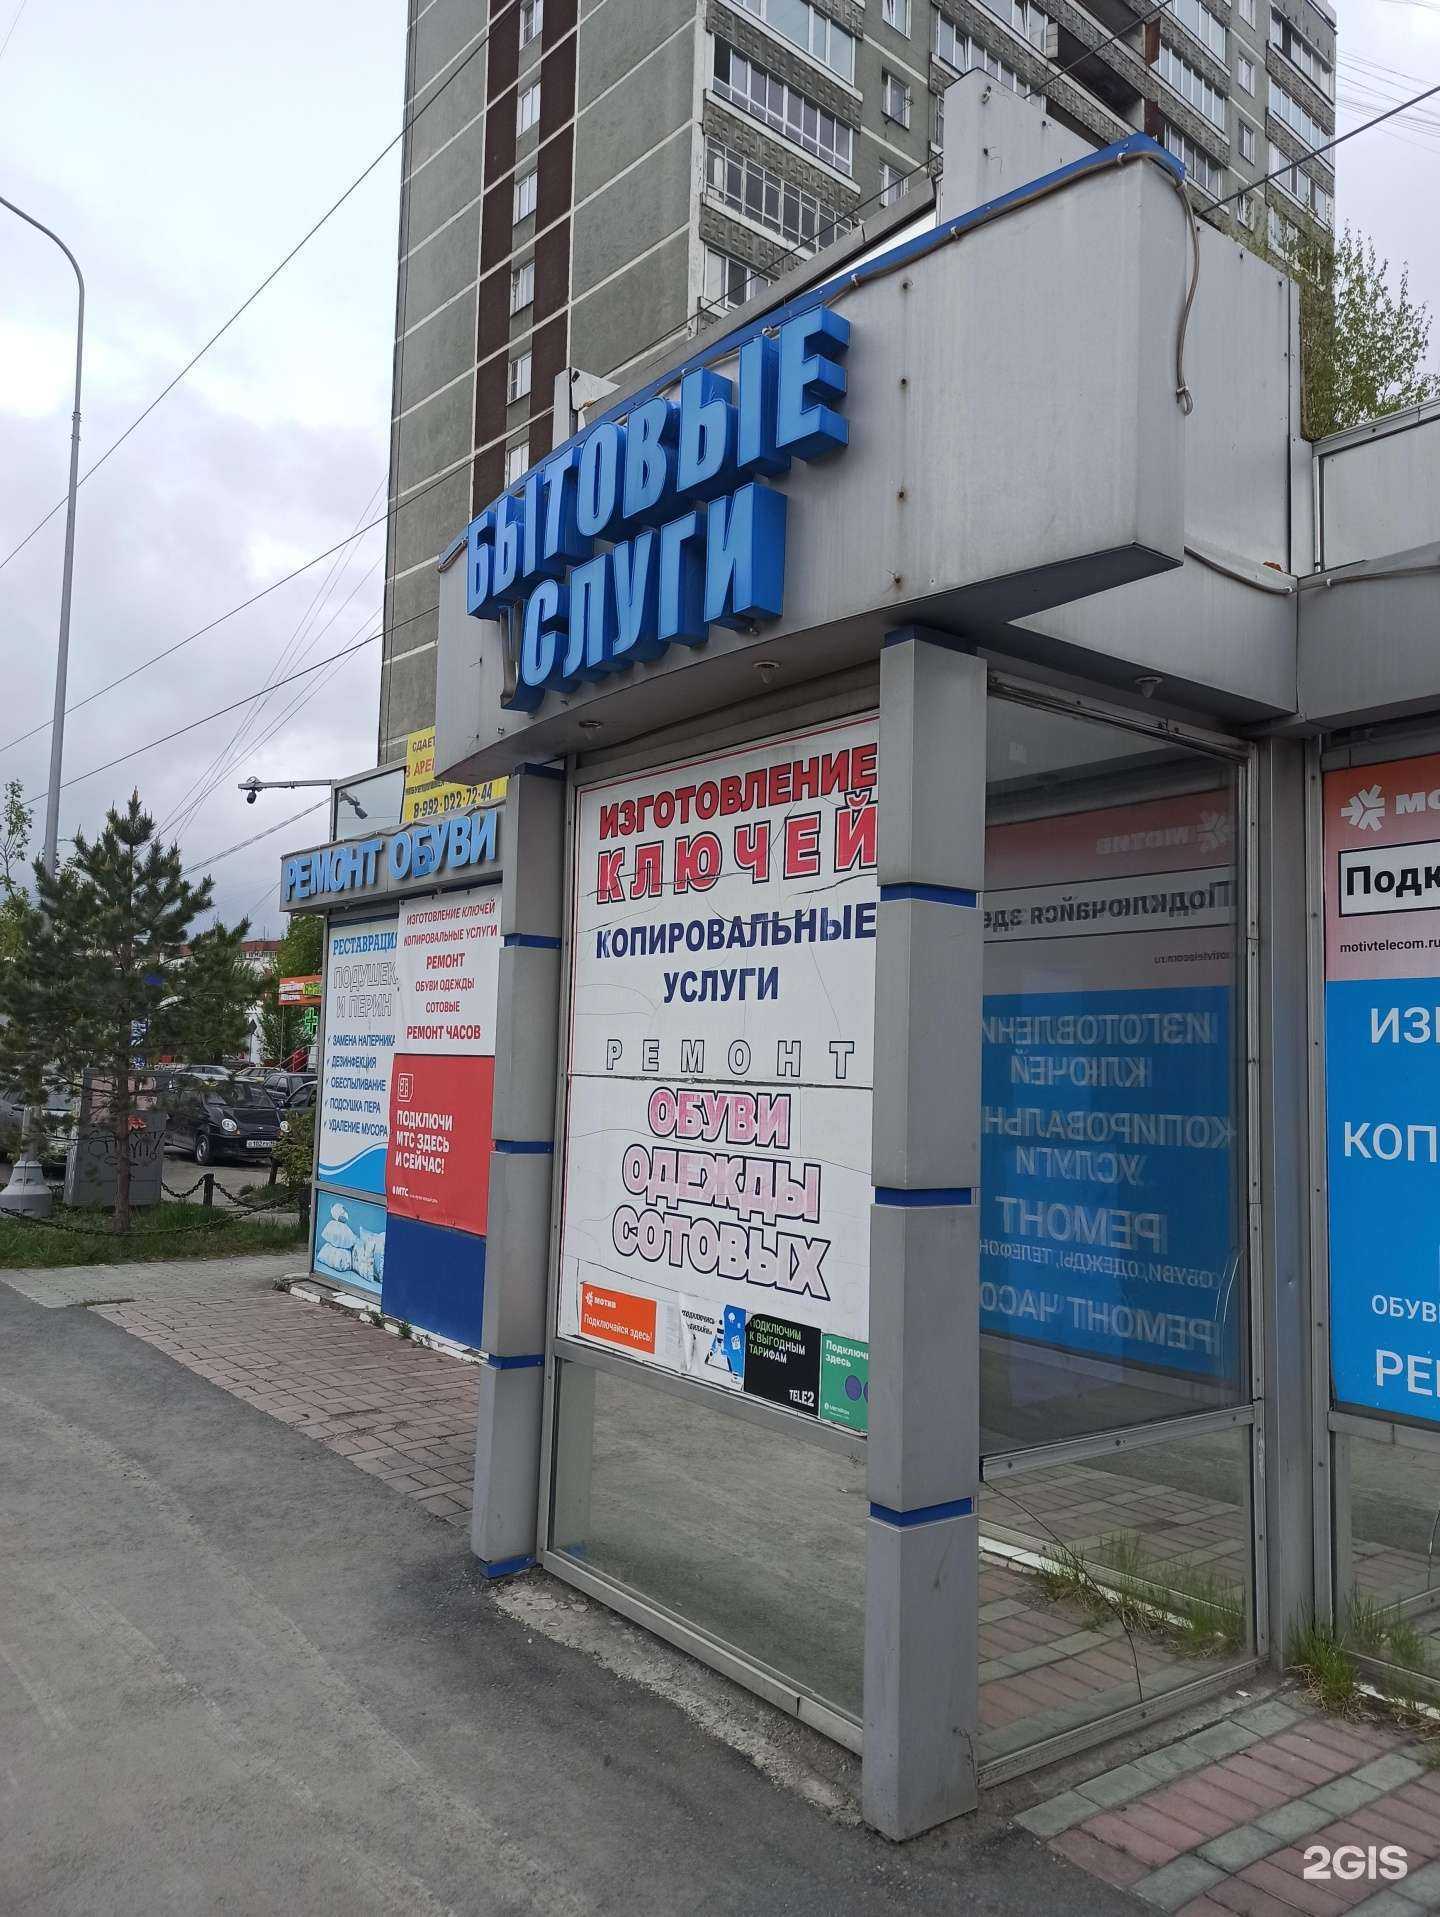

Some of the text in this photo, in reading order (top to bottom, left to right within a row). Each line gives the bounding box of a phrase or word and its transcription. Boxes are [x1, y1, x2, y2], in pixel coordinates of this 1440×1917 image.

[467, 305, 850, 621] БЫТОВЫЕ
[414, 758, 434, 776] АРЕ
[600, 743, 877, 840] ИЗГОТОВЛЕНИЕ
[285, 810, 498, 901] РЕМОНТ ОБУВИ
[597, 789, 877, 904] КЛЮЧЕЙ
[406, 898, 496, 925] ИЗГОТОВЛЕНИЕ КЛЮЧЕЙ
[404, 924, 498, 946] КОПИРОВАЛЬНЫЕ УСЛУГИ
[596, 902, 877, 958] КОПИРОВАЛЬНЫЕ
[333, 931, 397, 956] РЕСТАВРАЦИ
[1340, 937, 1440, 953] motivtelecom.ru
[426, 953, 465, 969] РЕМОНТ
[333, 961, 397, 992] ПОДУШЕК
[415, 978, 475, 992] ОБУВИ ОДЕЖДЫ
[664, 966, 779, 1003] УСЛУГИ
[336, 993, 392, 1018] И ПЕРИН
[425, 1000, 460, 1013] СОТОВЫЕ
[406, 1025, 481, 1040] РЕМОНТ ЧАСОВ
[1370, 1006, 1440, 1044] ИЗ
[332, 1034, 357, 1046] ЗАМЕНА
[331, 1056, 377, 1070] ДЕЗИНФЕКЦИЯ
[606, 1039, 855, 1079] РЕМОНТ
[330, 1077, 387, 1092] ОБЕСПЫЛИВАНИЕ
[363, 1100, 381, 1114] ПЕРА
[648, 1087, 791, 1149] ОБУВИ
[328, 1118, 388, 1138] УДАЛЕНИЕ МУСОРА
[396, 1110, 453, 1132] ПОДКЛЮЧИ
[396, 1130, 450, 1153] МТС ЗДЕСЬ
[1344, 1121, 1438, 1163] КОП
[395, 1149, 445, 1174] И СЕЙЧАС!
[622, 1144, 821, 1227] ОДЕЖДЫ
[612, 1204, 831, 1301] СОТОВЫХ
[1371, 1294, 1440, 1324] ОБУВ
[584, 1313, 653, 1344] Подключайся здесь!
[749, 1318, 801, 1340] ПОДКЛЮЧИМ
[748, 1344, 787, 1364] ТАРИФАМ
[749, 1331, 806, 1355] К ВЫГОДНЫМ
[825, 1354, 851, 1367] здесь
[1375, 1348, 1440, 1398] РЕ
[789, 1389, 815, 1407] TELE2
